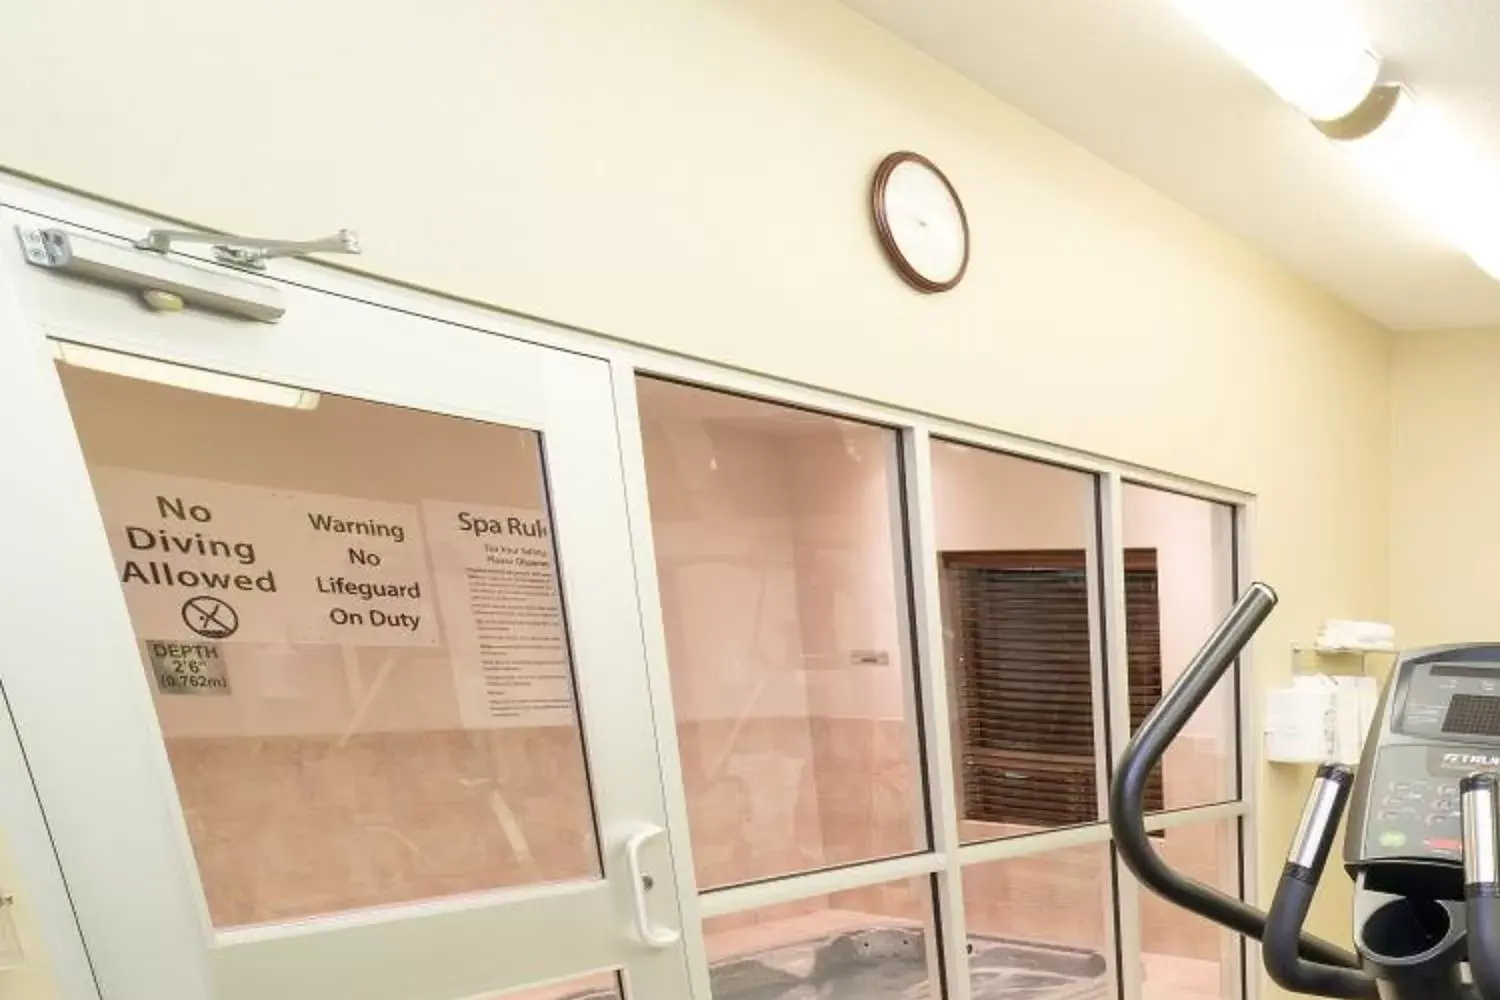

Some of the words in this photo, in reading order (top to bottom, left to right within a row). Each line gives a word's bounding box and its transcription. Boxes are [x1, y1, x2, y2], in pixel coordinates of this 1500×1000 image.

[156, 495, 212, 523] No
[308, 512, 405, 543] Warning
[457, 511, 502, 537] Spa
[125, 525, 256, 565] Diving
[348, 547, 381, 567] No
[121, 559, 277, 593] Allowed
[315, 575, 421, 601] Lifeguard
[329, 607, 363, 625] On
[369, 609, 421, 632] Duty
[153, 643, 219, 659] DEPTH
